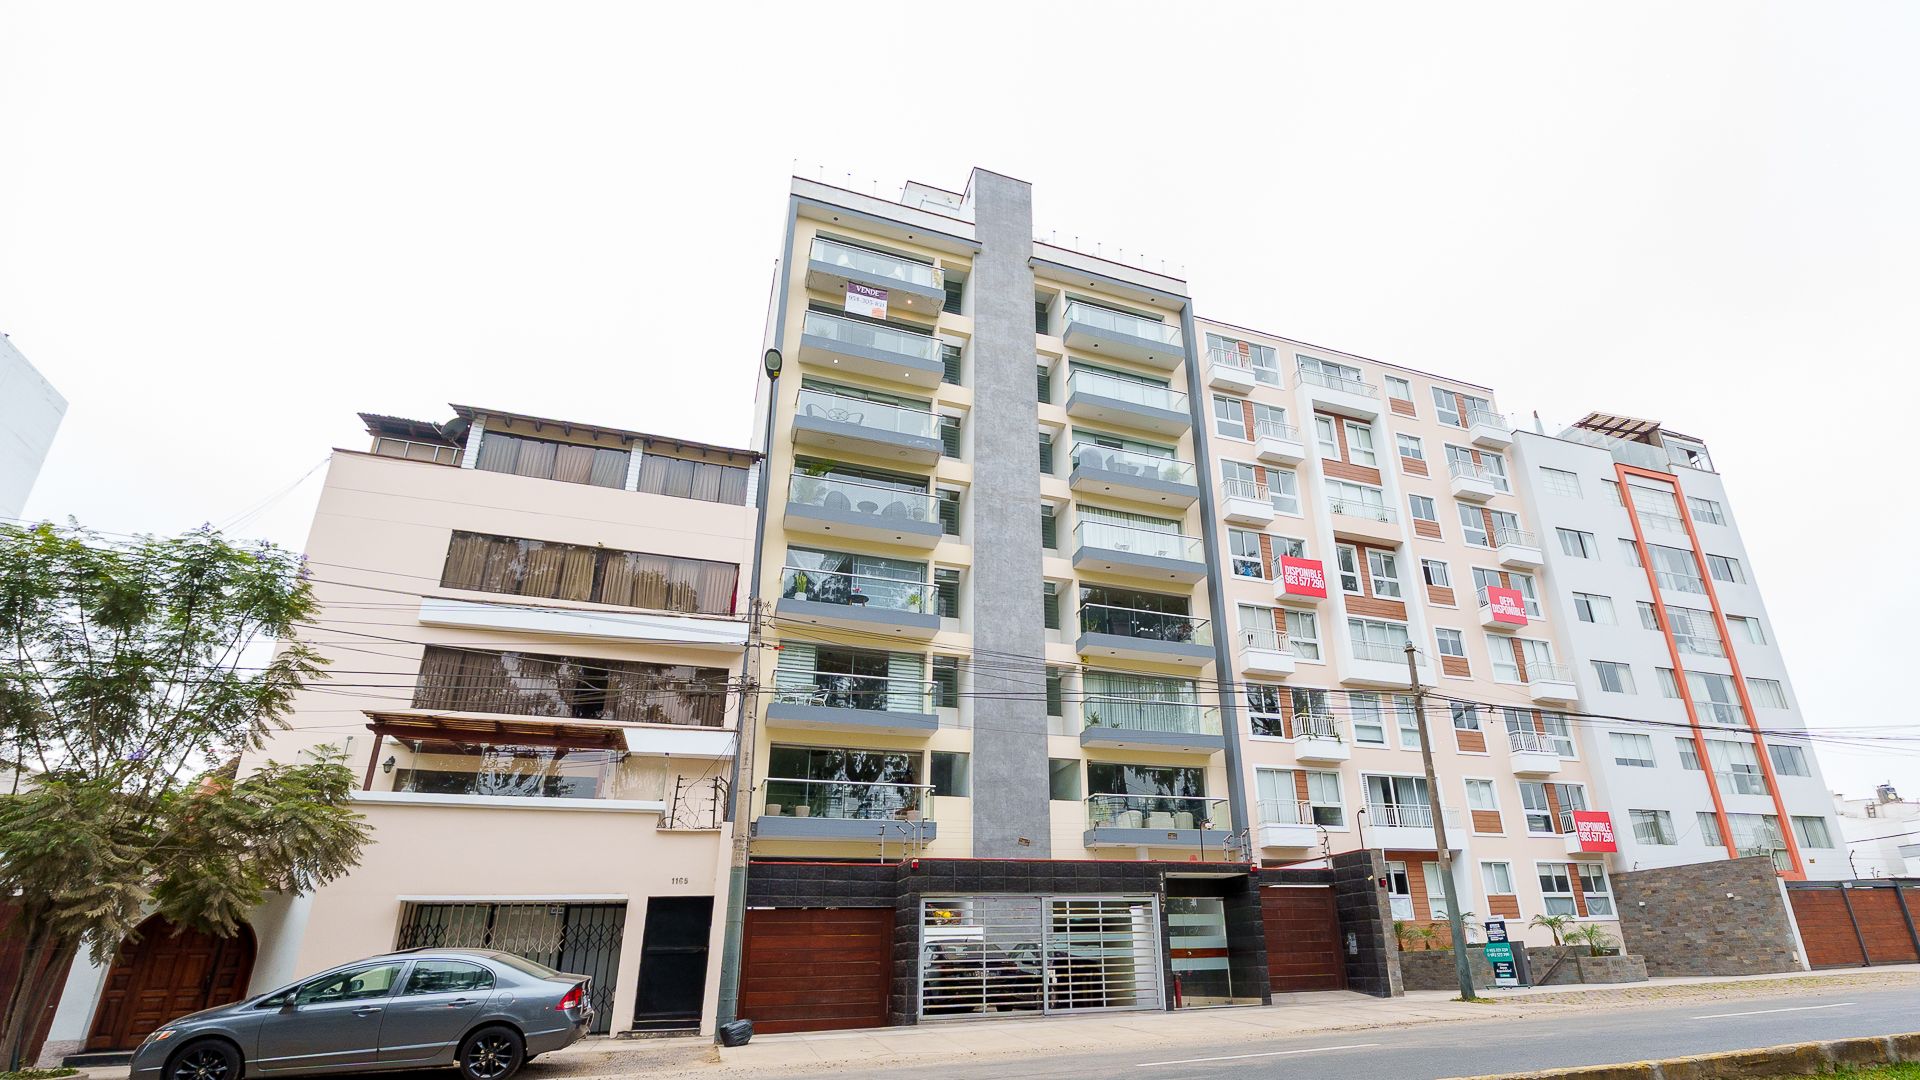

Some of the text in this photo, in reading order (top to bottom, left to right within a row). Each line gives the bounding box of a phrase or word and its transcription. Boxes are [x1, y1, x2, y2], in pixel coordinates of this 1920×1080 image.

[856, 285, 880, 297] VENDE
[1284, 565, 1322, 580] DISPONIBLE
[1285, 574, 1325, 589] 983 577 290
[1499, 595, 1515, 607] DEPA
[1491, 604, 1526, 618] DISPONIBLE
[1577, 821, 1611, 833] DISPONIBLE
[1579, 831, 1615, 843] 983 577 290
